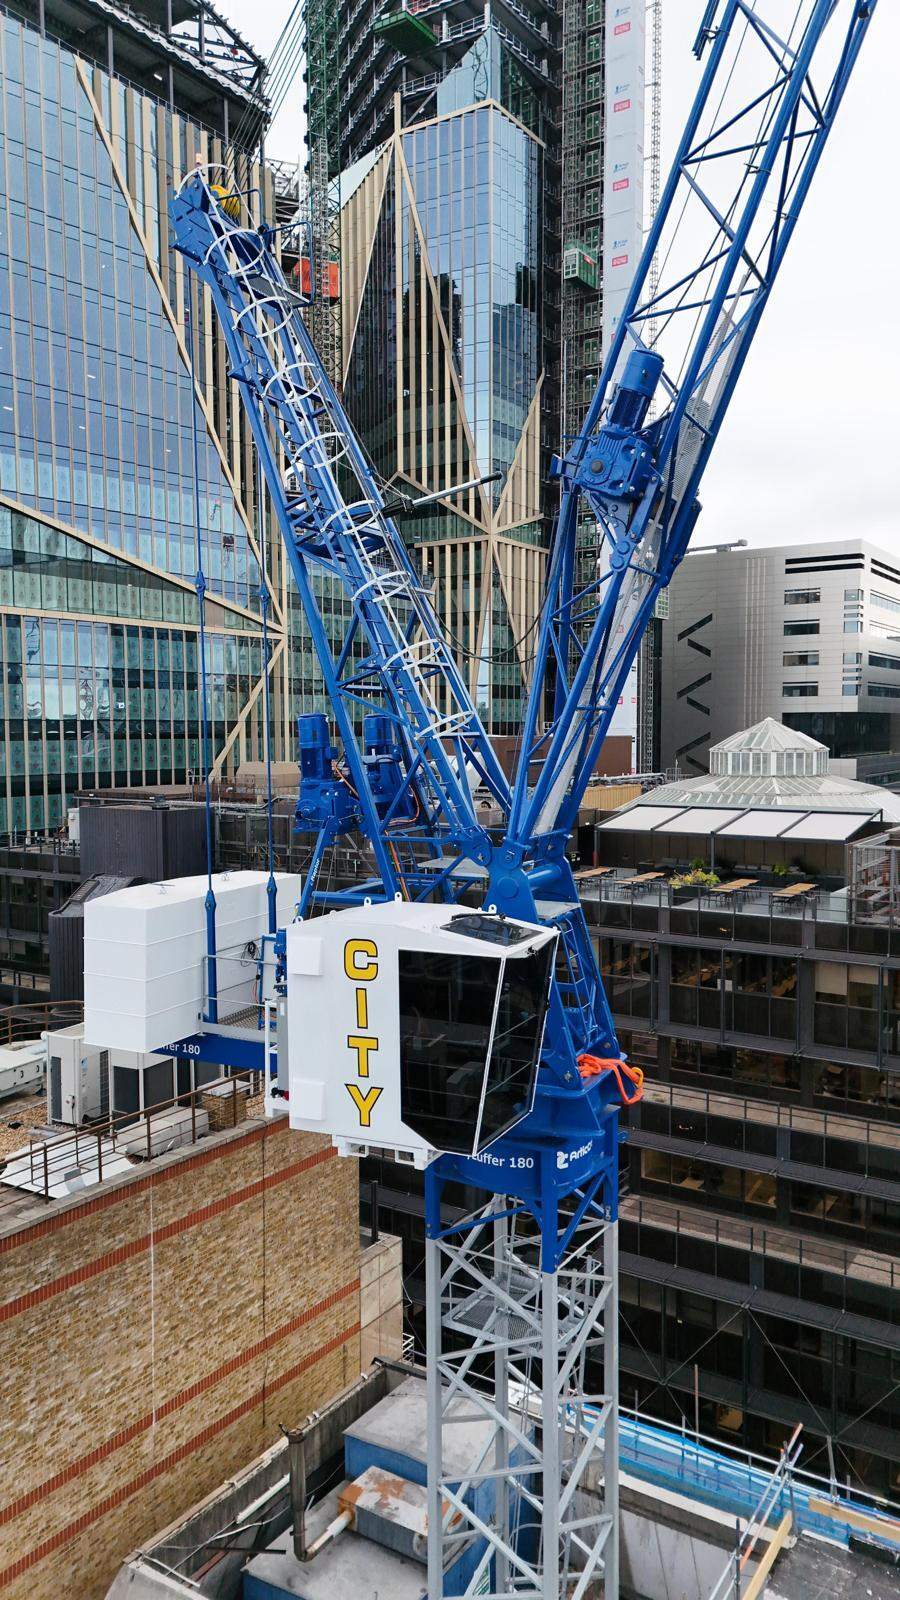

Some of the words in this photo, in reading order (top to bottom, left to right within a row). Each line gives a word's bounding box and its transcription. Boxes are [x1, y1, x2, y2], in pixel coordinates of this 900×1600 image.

[343, 938, 384, 1127] CITY
[182, 1043, 201, 1055] 180
[509, 1157, 534, 1169] 180
